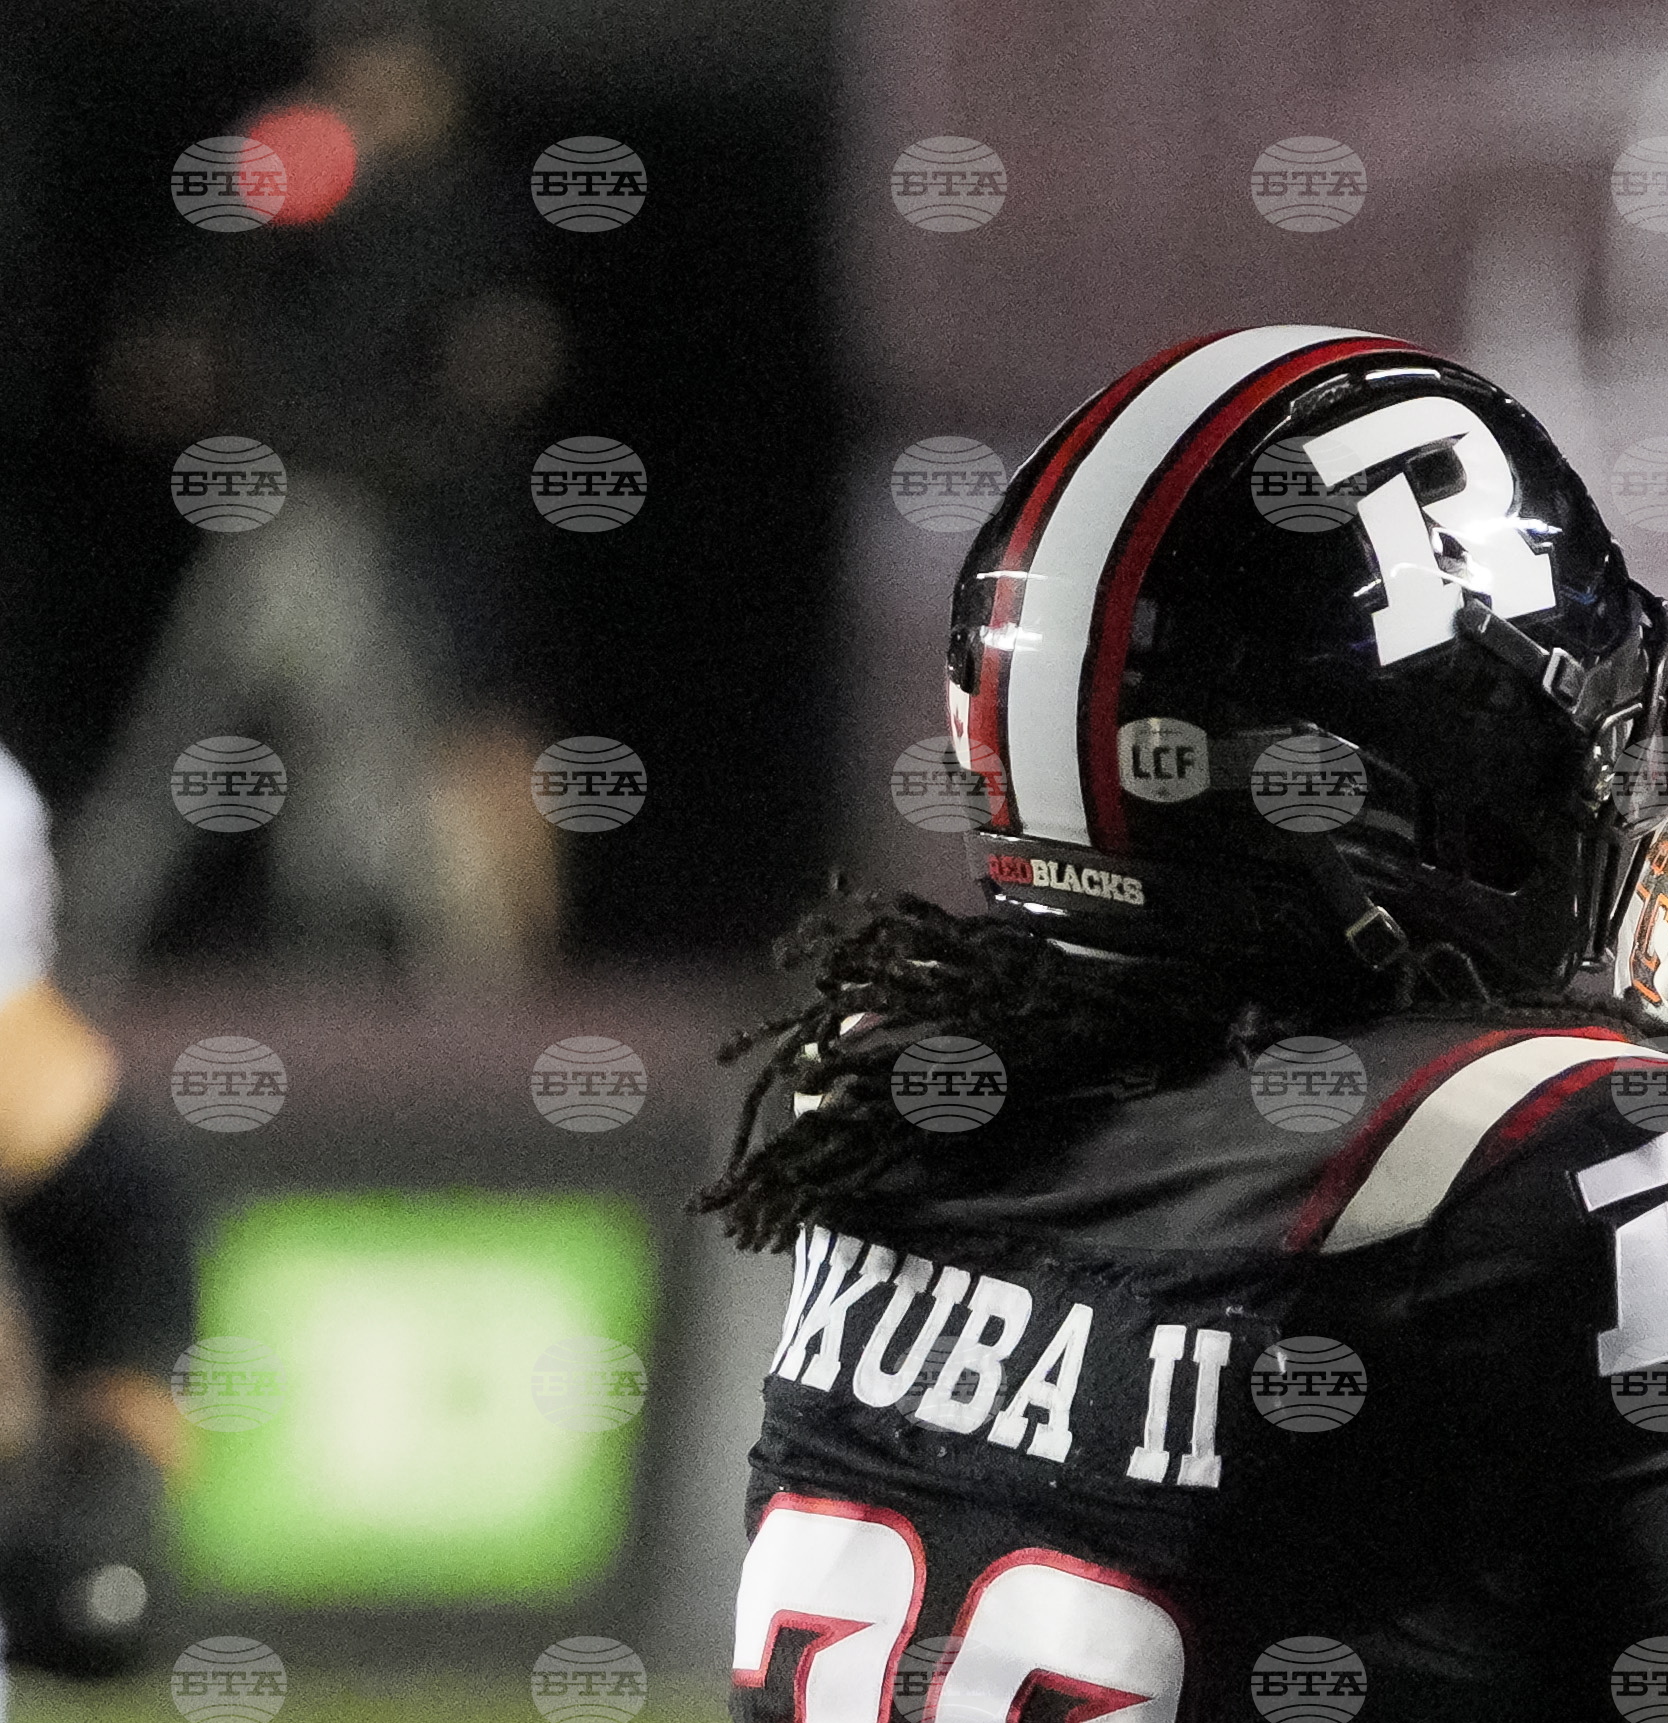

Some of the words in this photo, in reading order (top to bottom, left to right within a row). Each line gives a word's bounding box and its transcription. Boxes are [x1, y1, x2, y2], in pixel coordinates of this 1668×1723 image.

[1303, 396, 1557, 666] R
[1132, 745, 1195, 780] LCF
[1126, 1324, 1231, 1488] II
